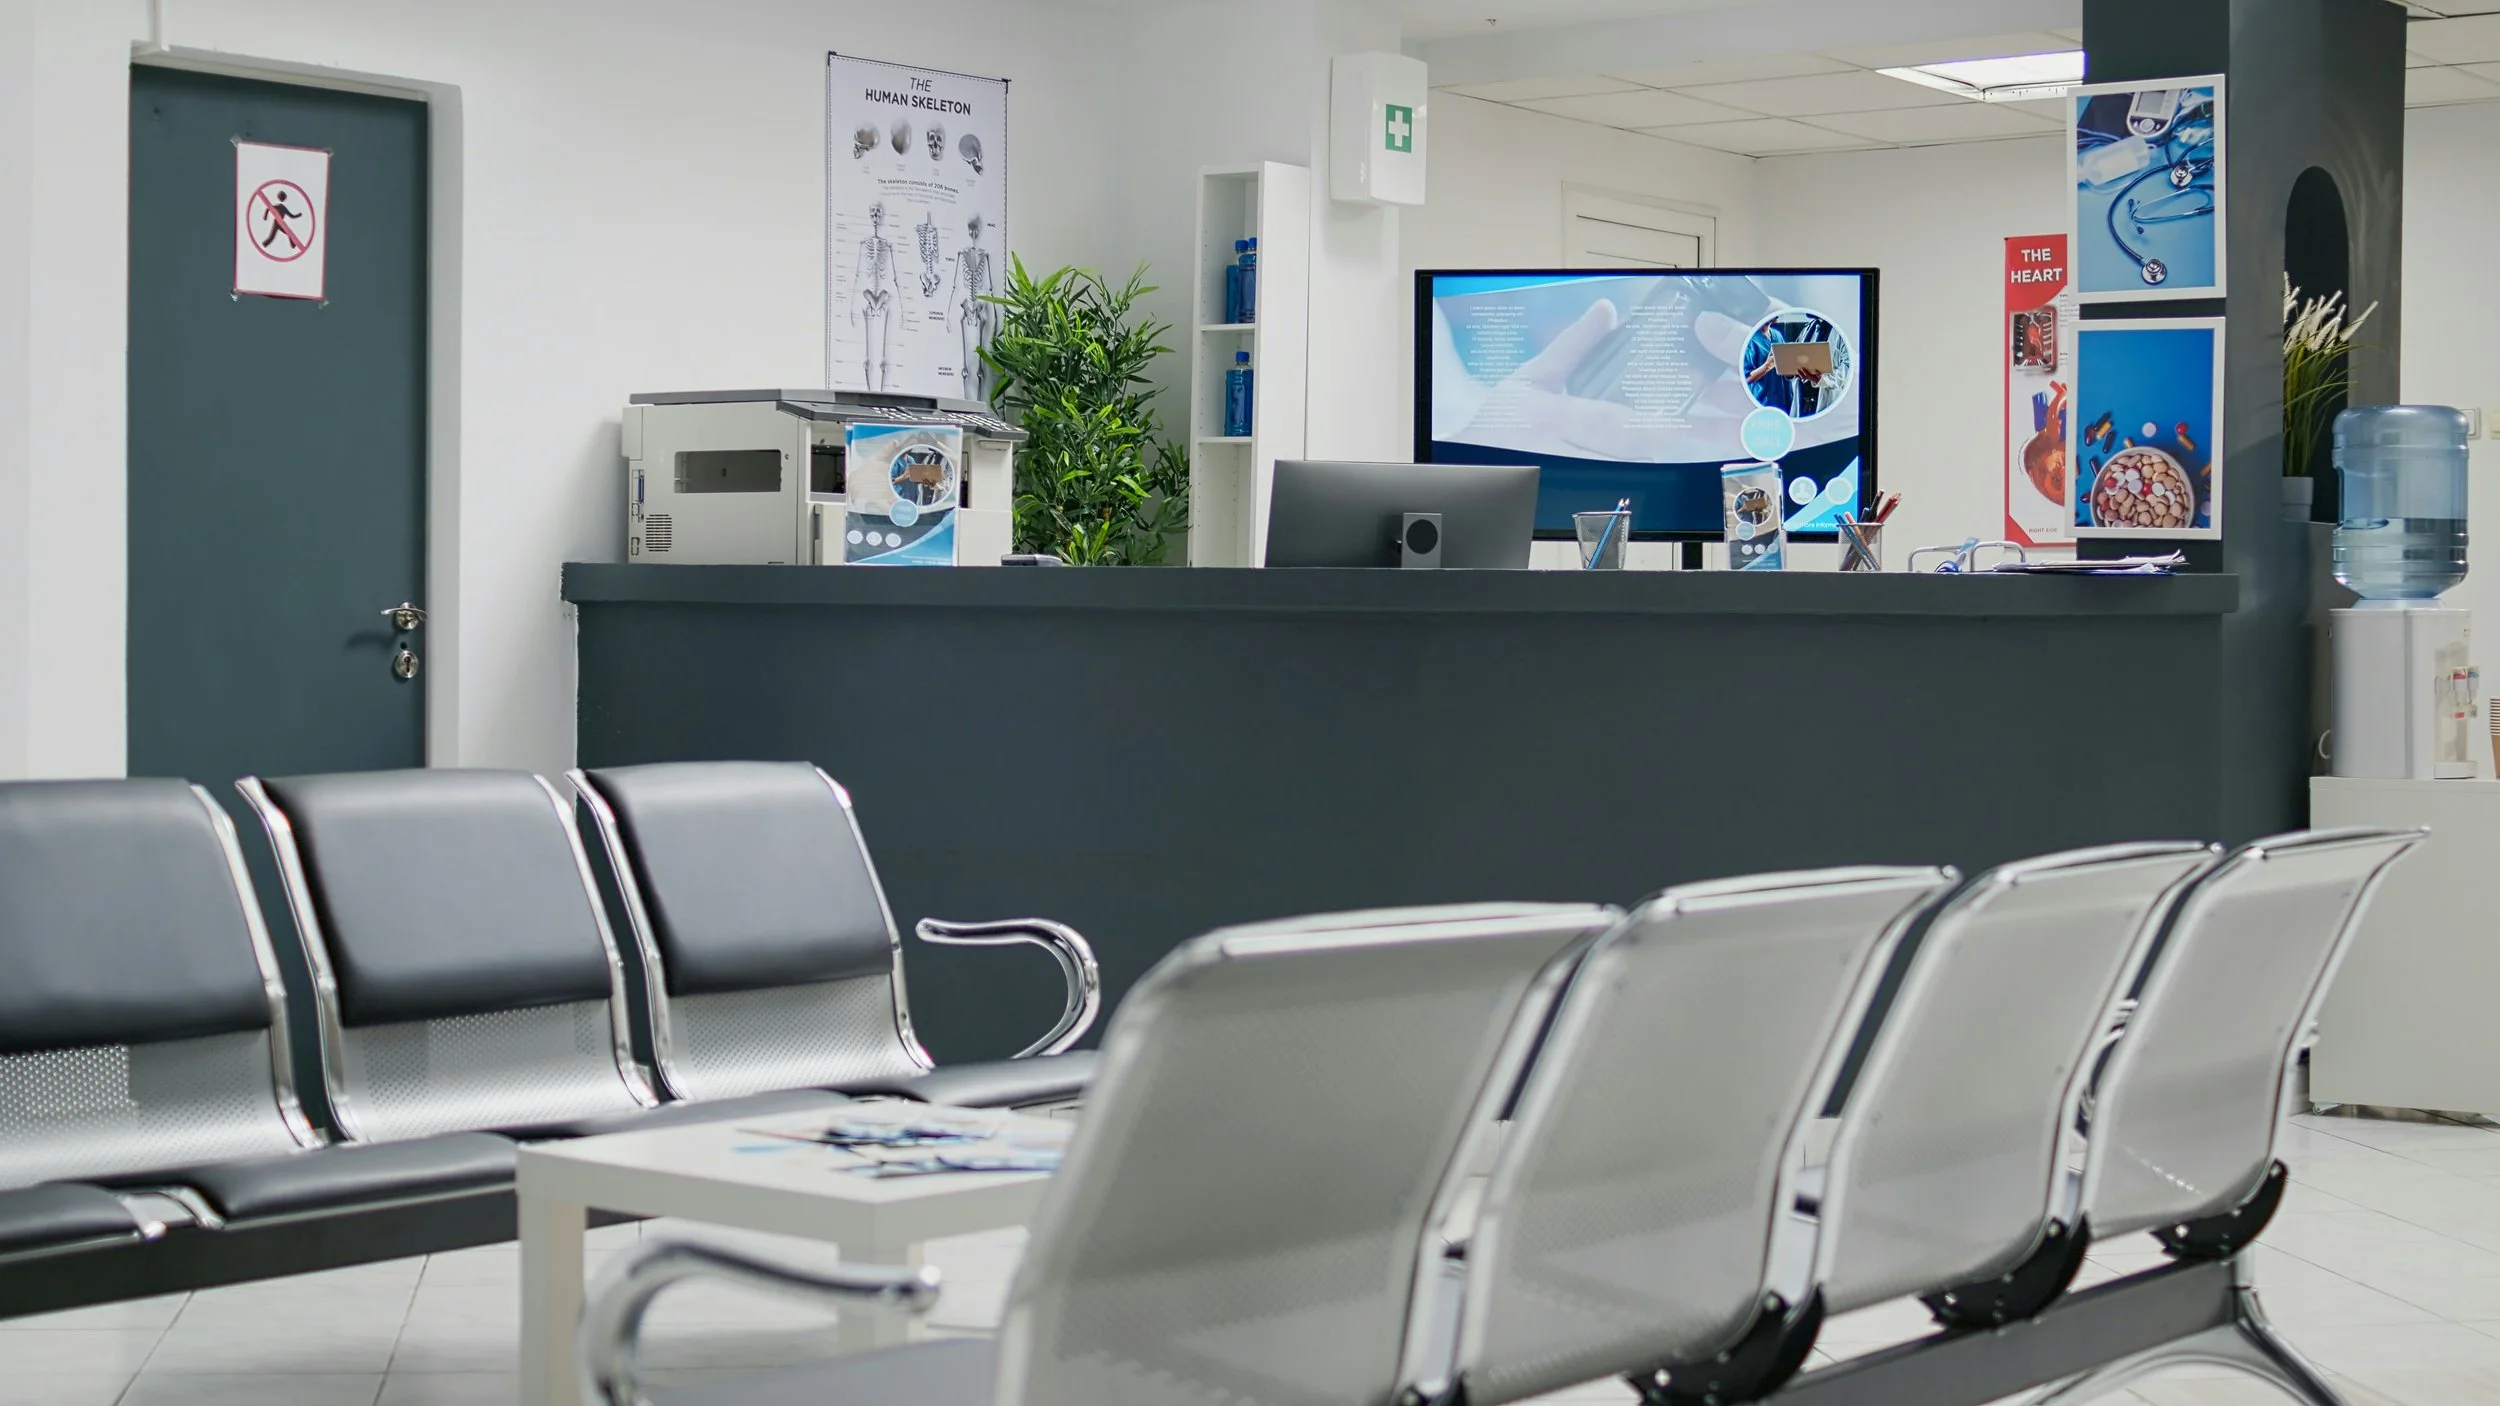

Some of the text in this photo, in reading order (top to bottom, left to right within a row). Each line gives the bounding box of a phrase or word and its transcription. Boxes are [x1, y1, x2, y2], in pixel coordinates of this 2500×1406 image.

[910, 77, 933, 92] THE
[865, 88, 971, 115] HUMAN SKELETON
[908, 180, 927, 188] consists
[2021, 248, 2051, 262] THE
[2010, 268, 2062, 283] HEART
